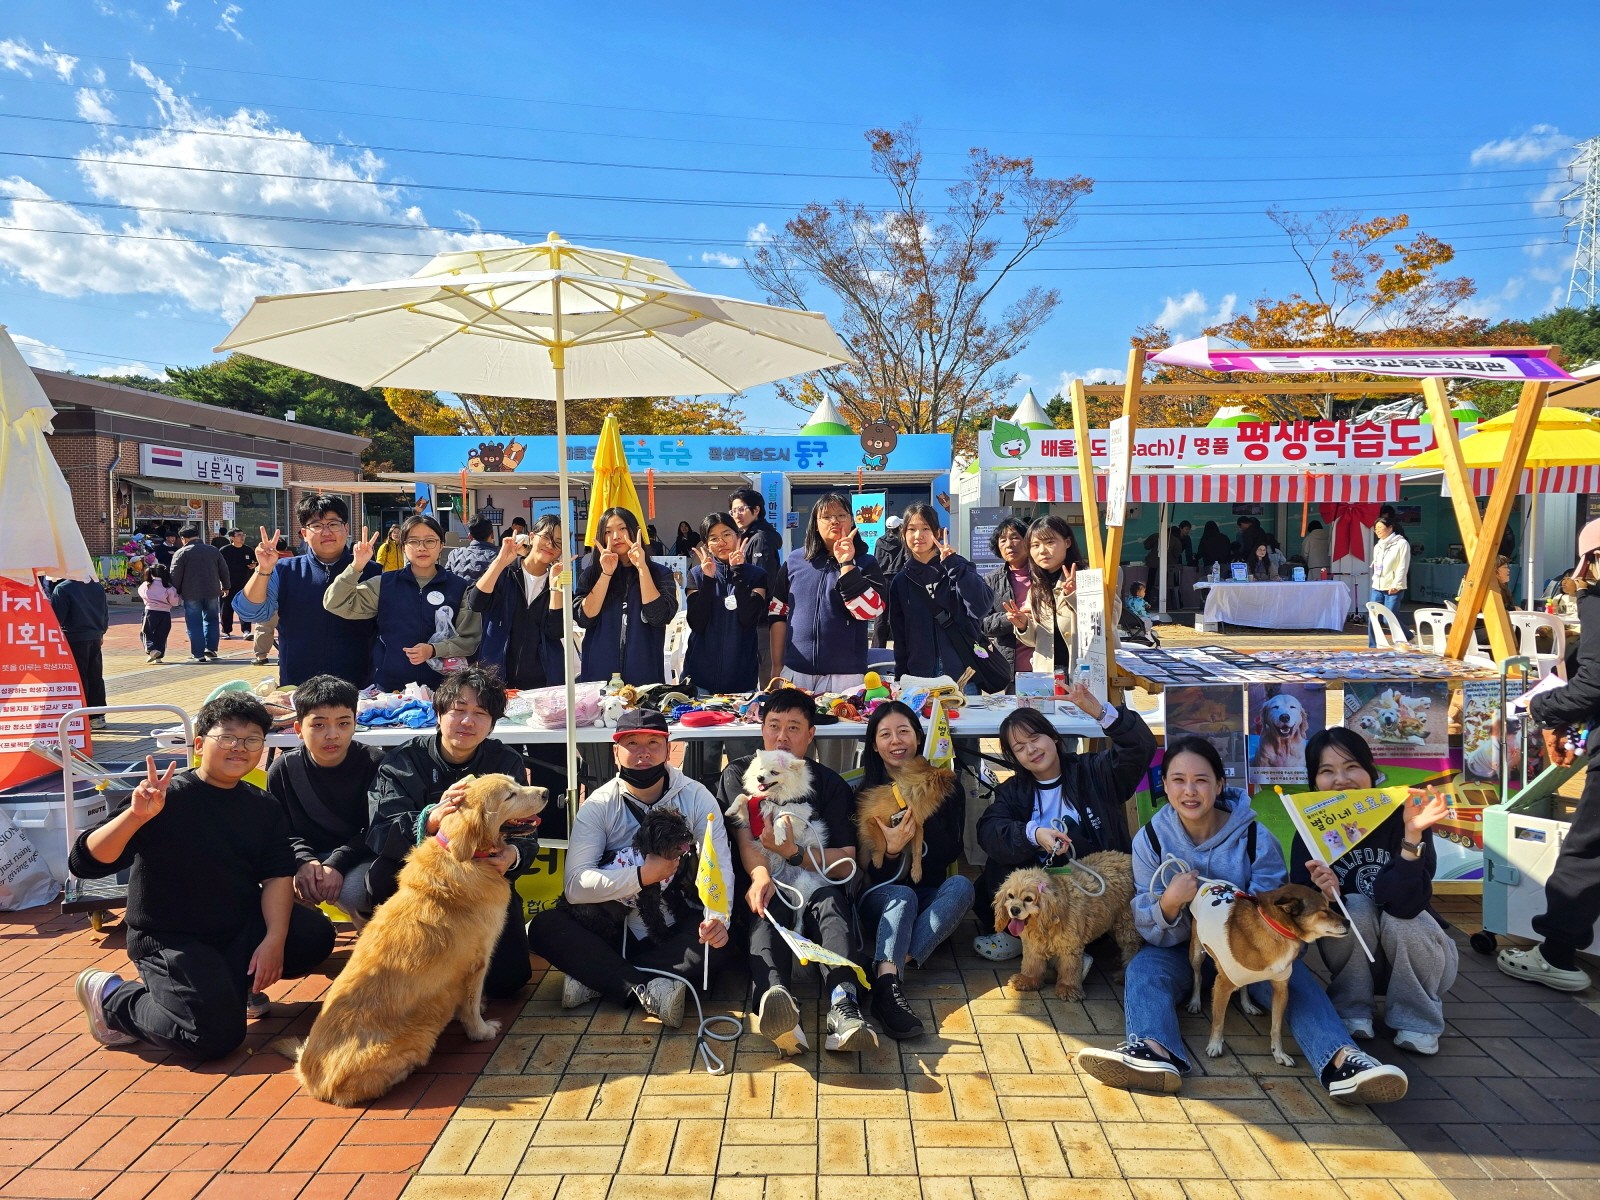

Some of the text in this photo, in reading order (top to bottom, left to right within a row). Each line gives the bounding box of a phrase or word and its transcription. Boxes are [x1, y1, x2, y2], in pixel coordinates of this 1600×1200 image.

[659, 440, 693, 466] 두근
[708, 446, 791, 461] 평생학습도시
[794, 440, 828, 469] 동구
[1041, 439, 1107, 457] 배울도
[1194, 437, 1229, 456] 명품
[197, 460, 244, 482] 남문식당
[88, 805, 106, 816] BRUTE
[1353, 793, 1392, 815] 보호소
[7, 860, 29, 883] giving
